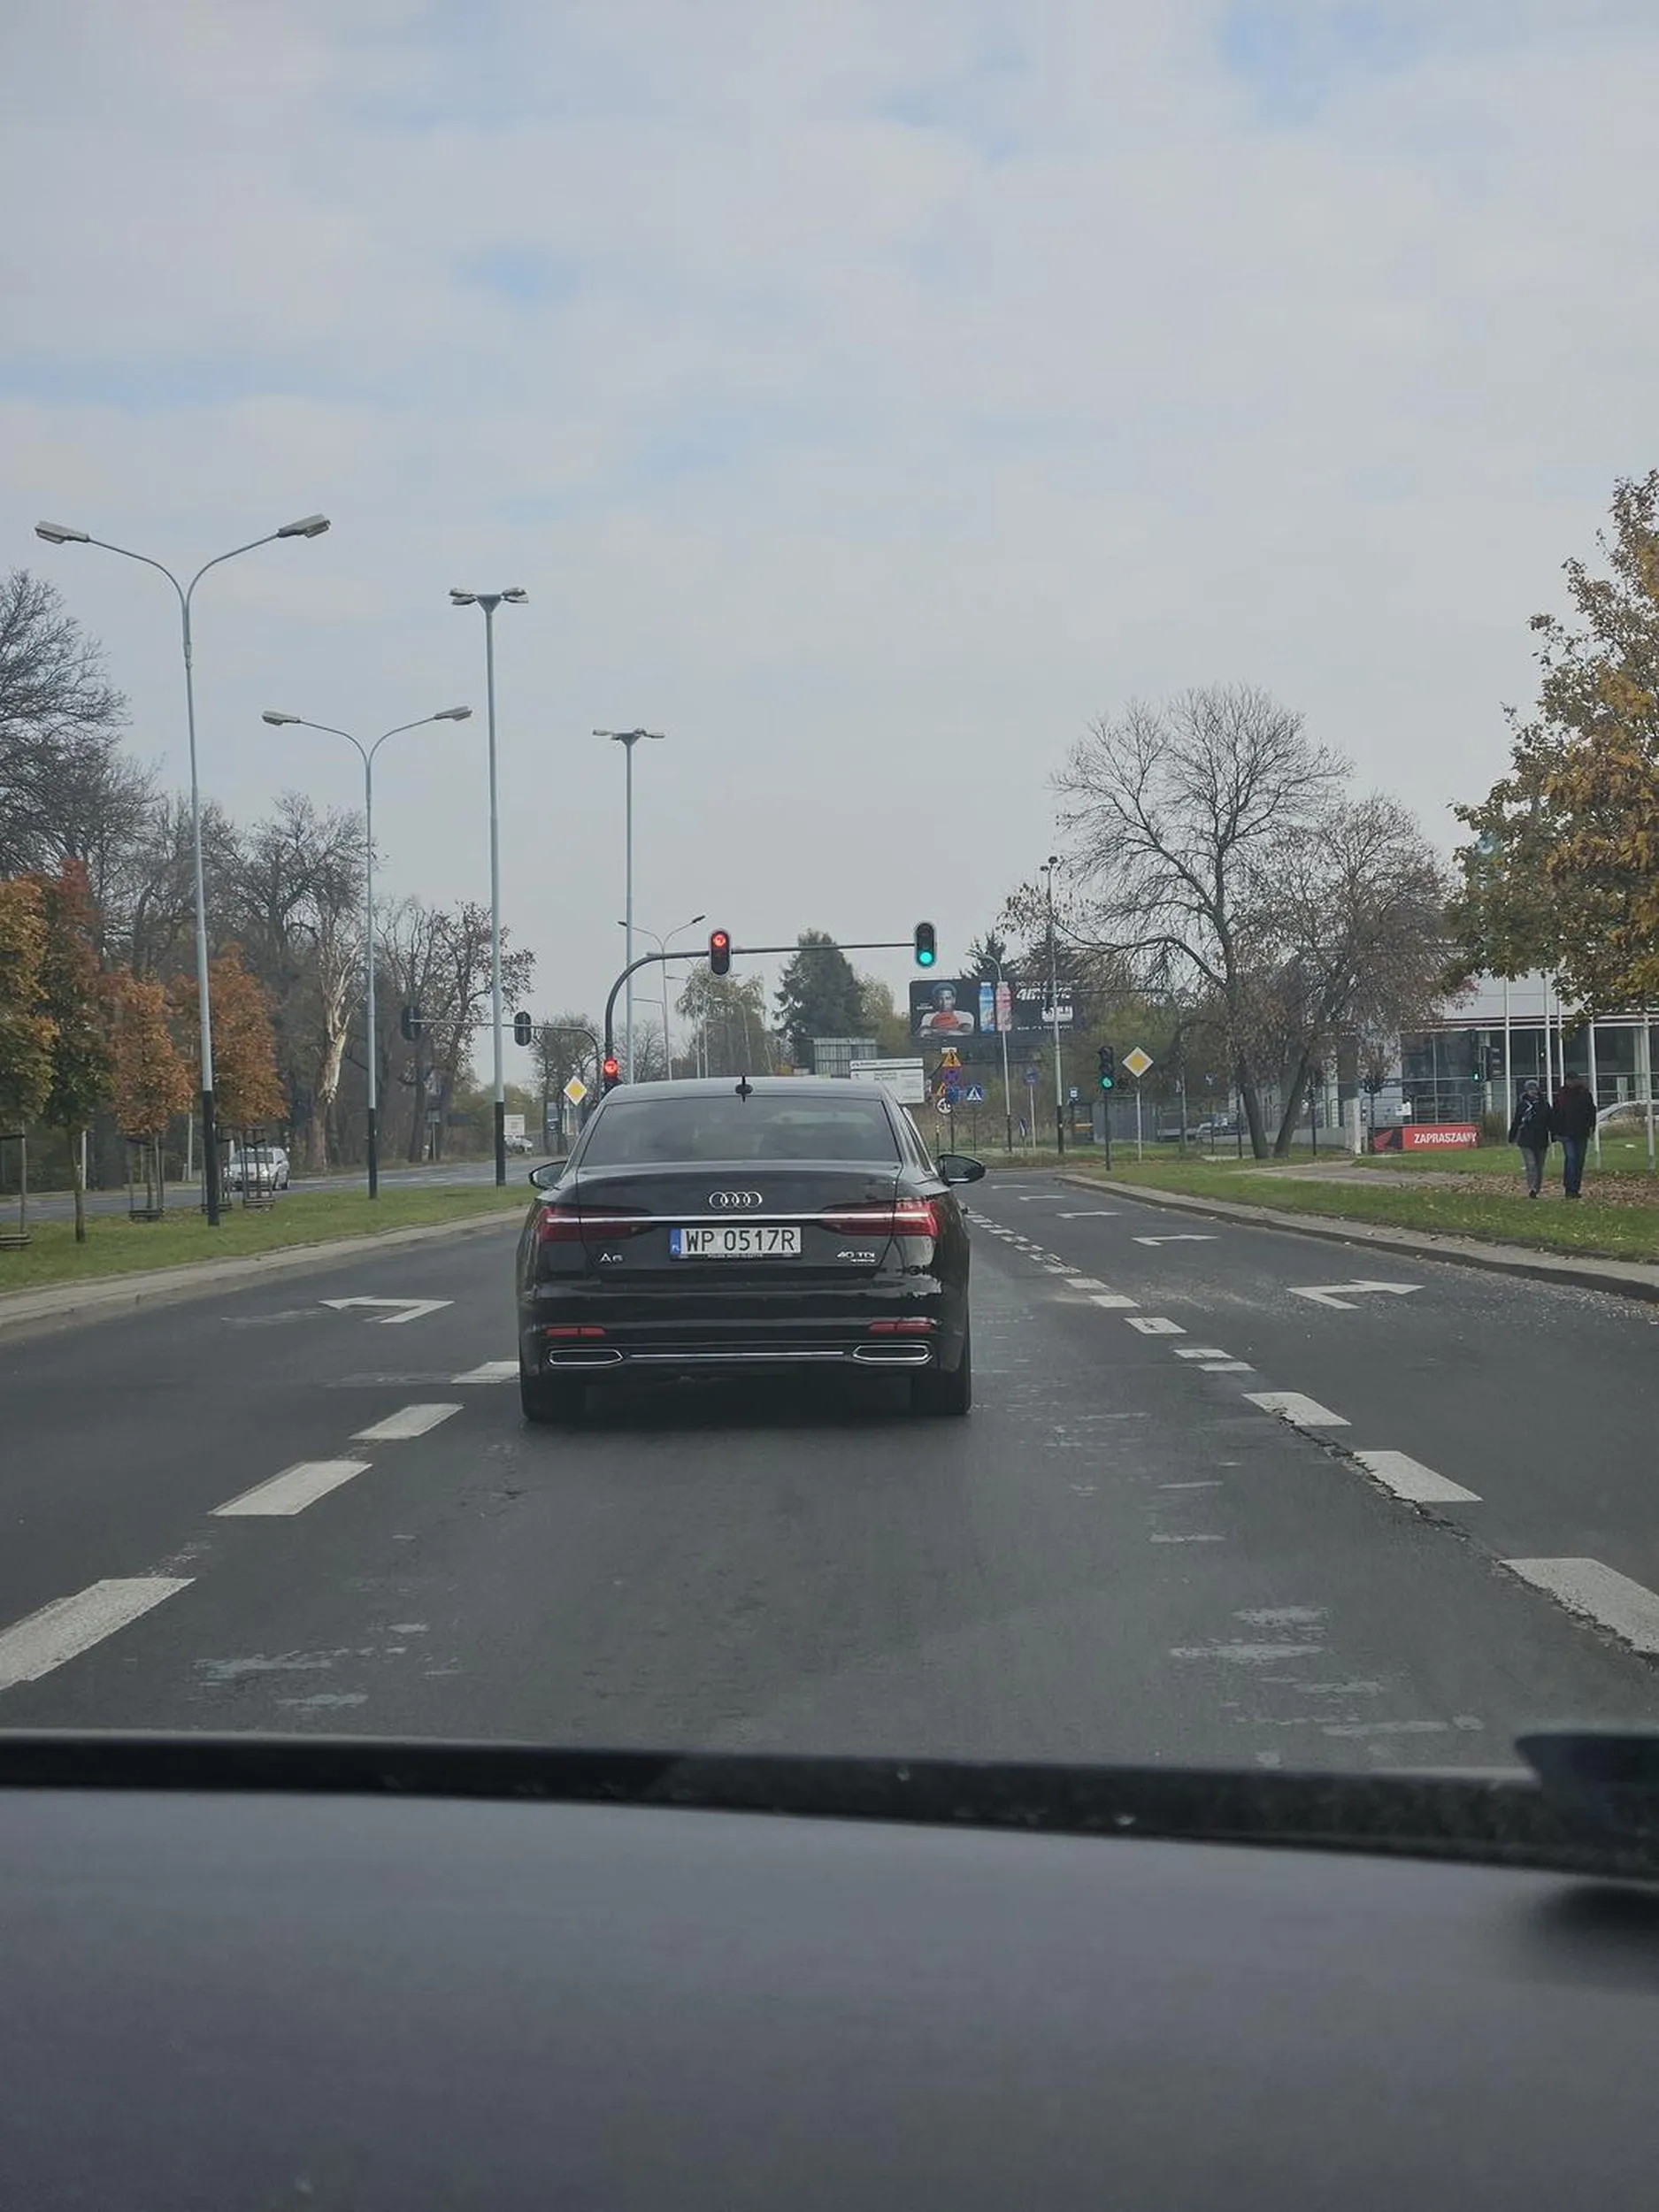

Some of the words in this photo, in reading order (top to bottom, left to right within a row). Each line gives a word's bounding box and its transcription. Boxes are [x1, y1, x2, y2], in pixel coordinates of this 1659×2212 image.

[1414, 1133, 1477, 1144] ZAPRASZAMY
[686, 1230, 715, 1252] WP
[724, 1229, 795, 1251] 0517R
[600, 1253, 623, 1263] A6
